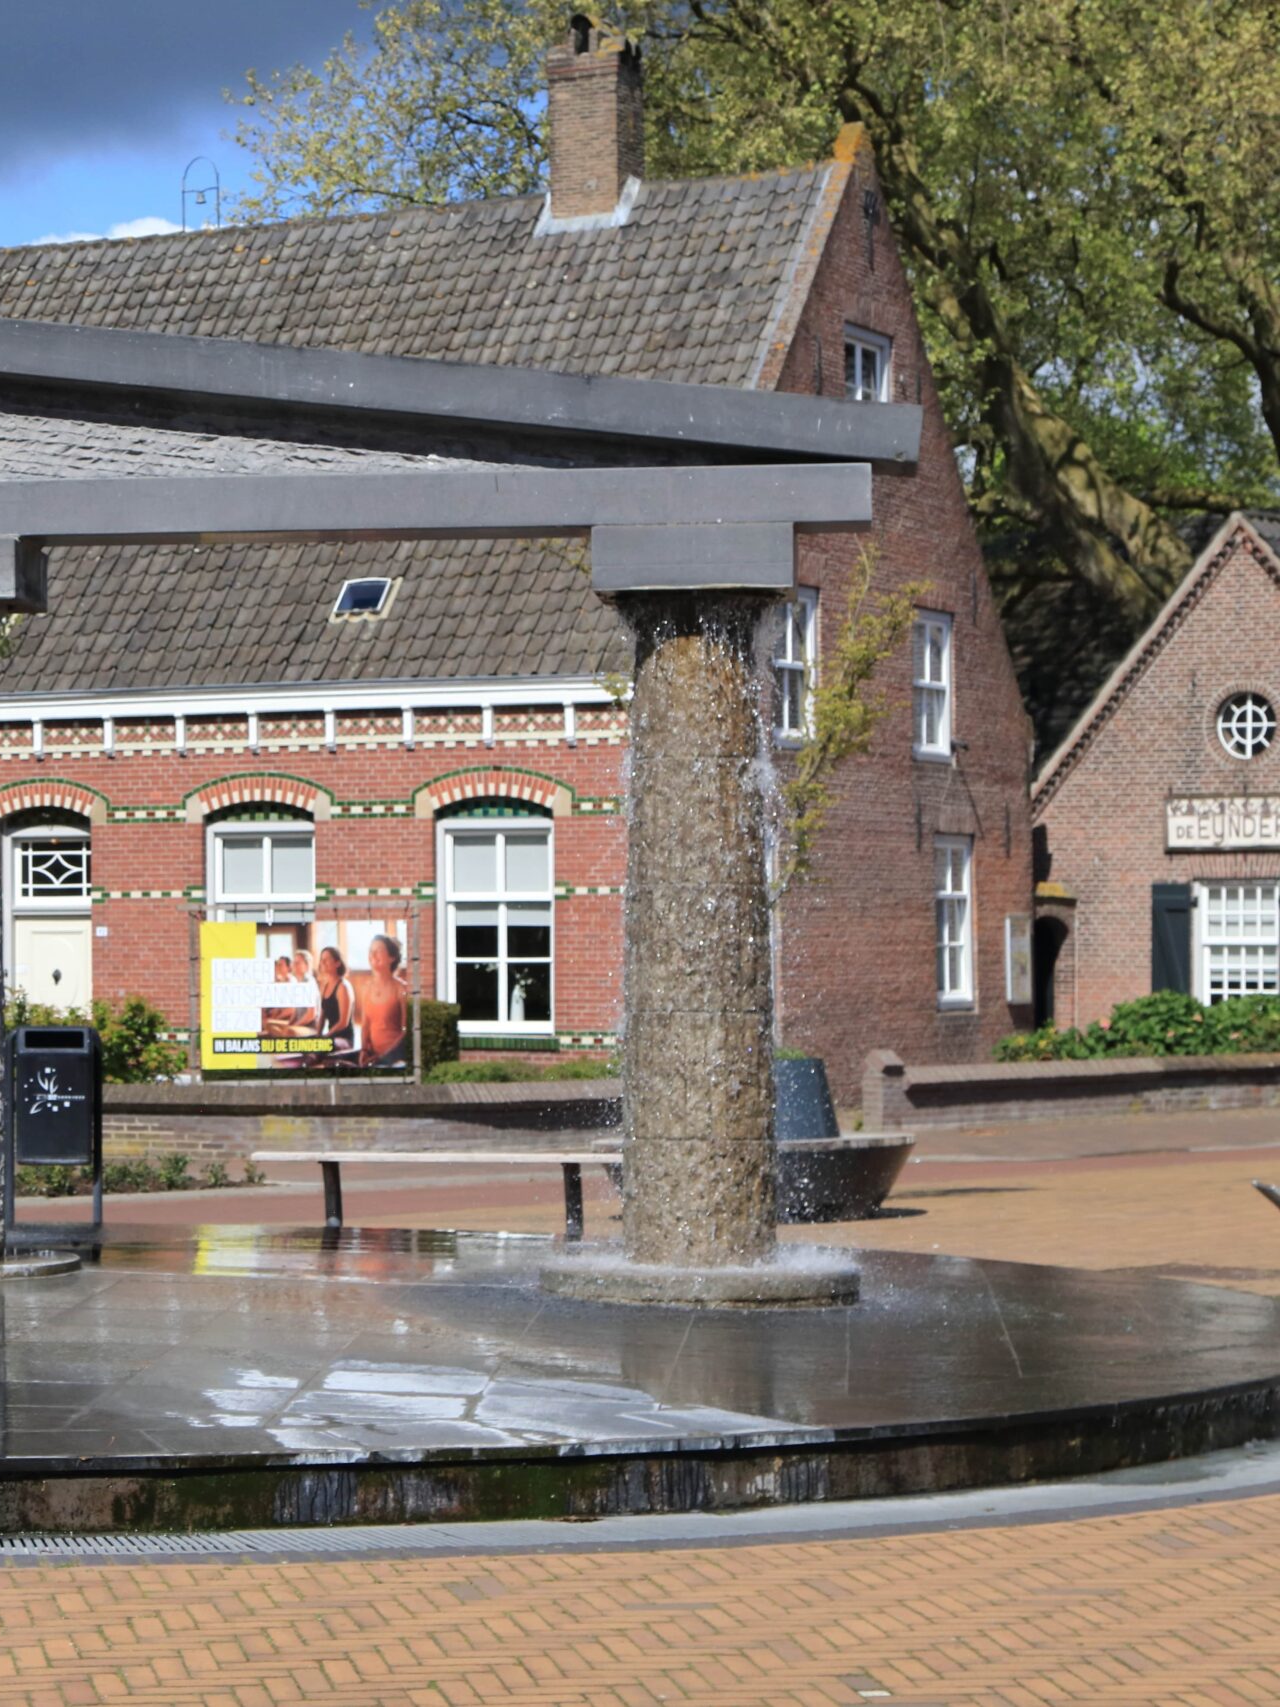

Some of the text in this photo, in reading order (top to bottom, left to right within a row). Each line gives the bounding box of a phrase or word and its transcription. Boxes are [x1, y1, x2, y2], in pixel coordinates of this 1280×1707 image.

[1176, 826, 1193, 839] DE
[214, 960, 272, 980] LEKKER
[214, 1039, 224, 1052] IN
[225, 1039, 260, 1052] BALANS
[275, 1039, 287, 1052] DE
